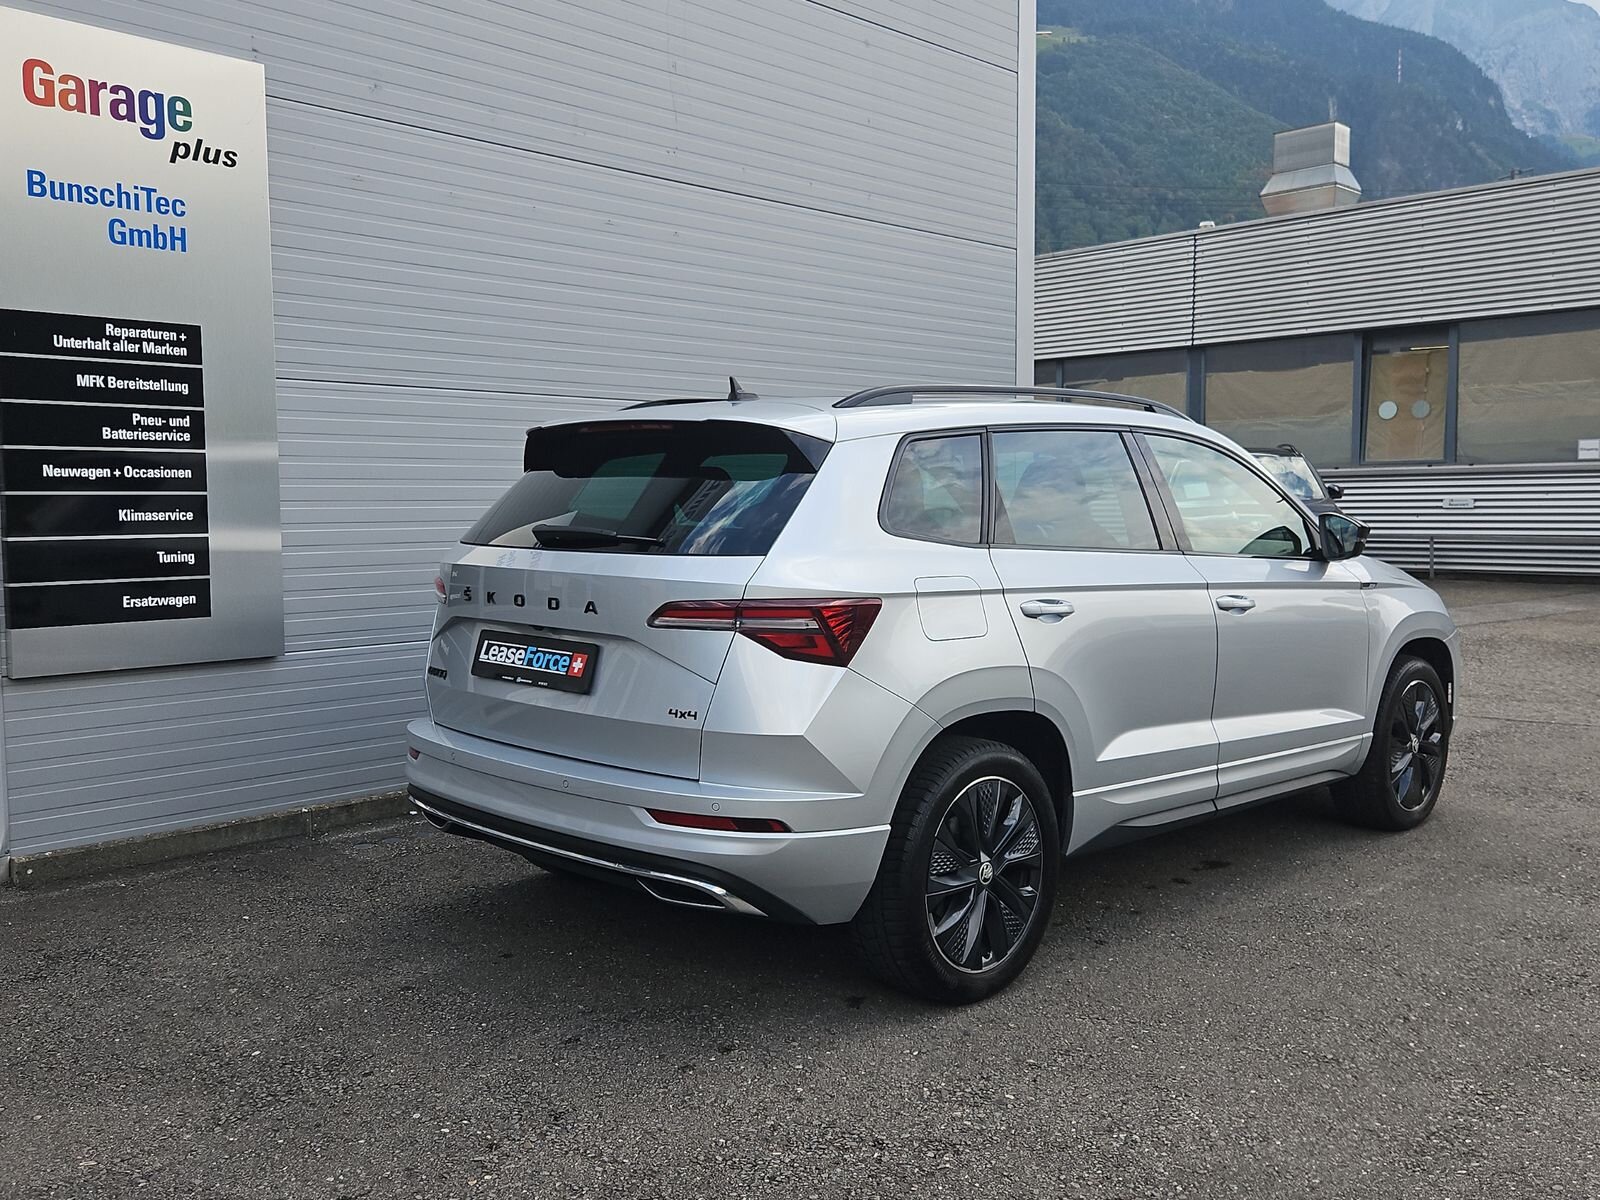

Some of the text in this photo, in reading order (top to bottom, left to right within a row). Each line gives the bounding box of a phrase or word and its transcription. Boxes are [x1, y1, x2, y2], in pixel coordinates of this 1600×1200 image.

[22, 58, 193, 140] Garage
[169, 138, 238, 168] plus
[26, 169, 187, 217] BunschiTec
[108, 218, 187, 253] GmbH
[105, 323, 177, 342] Reparaturen
[53, 334, 188, 356] Unterhalt aller Marken
[76, 374, 189, 395] MFK Bereitstellung
[132, 413, 190, 427] Pneu- und
[102, 427, 191, 442] Batterieservice
[42, 464, 111, 480] Neuwagen
[124, 465, 192, 479] Occasionen
[118, 509, 194, 521] Klimaservice
[156, 551, 195, 564] Tuning
[122, 595, 196, 608] Ersatzwagen
[463, 586, 599, 615] ŠKODA
[479, 640, 570, 673] LeaseForce
[667, 708, 698, 721] 4x4
